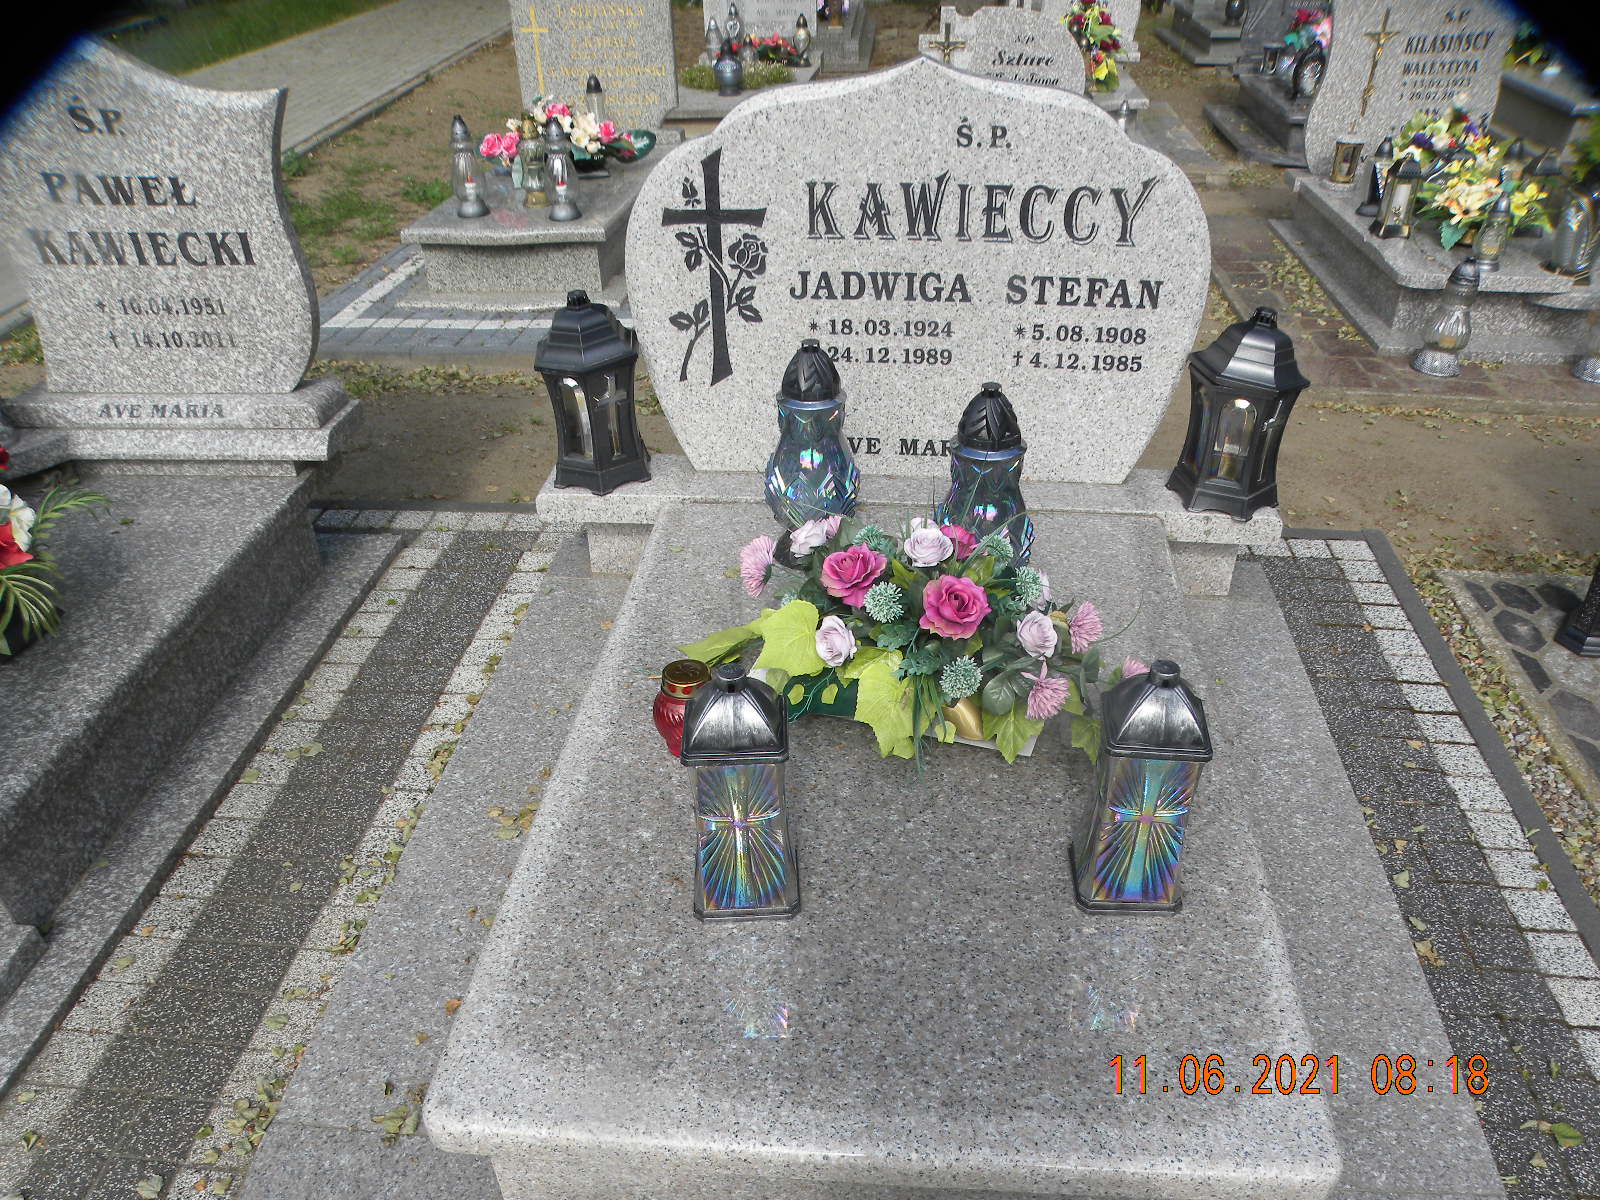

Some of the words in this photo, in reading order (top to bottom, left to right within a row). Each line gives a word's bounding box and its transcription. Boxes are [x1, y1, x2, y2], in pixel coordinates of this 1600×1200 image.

[41, 171, 198, 208] PAWEŁ
[805, 170, 1160, 247] KAWIECCY
[26, 229, 257, 266] KAWIECKI
[790, 271, 972, 302] JADWIGA
[1006, 274, 1164, 309] STEFAN
[828, 318, 953, 338] 18.03.1924
[827, 346, 952, 366] 24.12.1989
[1029, 354, 1143, 372] 4.12.1985
[99, 404, 142, 418] AVE
[151, 404, 225, 419] MARIA
[847, 437, 882, 455] VE
